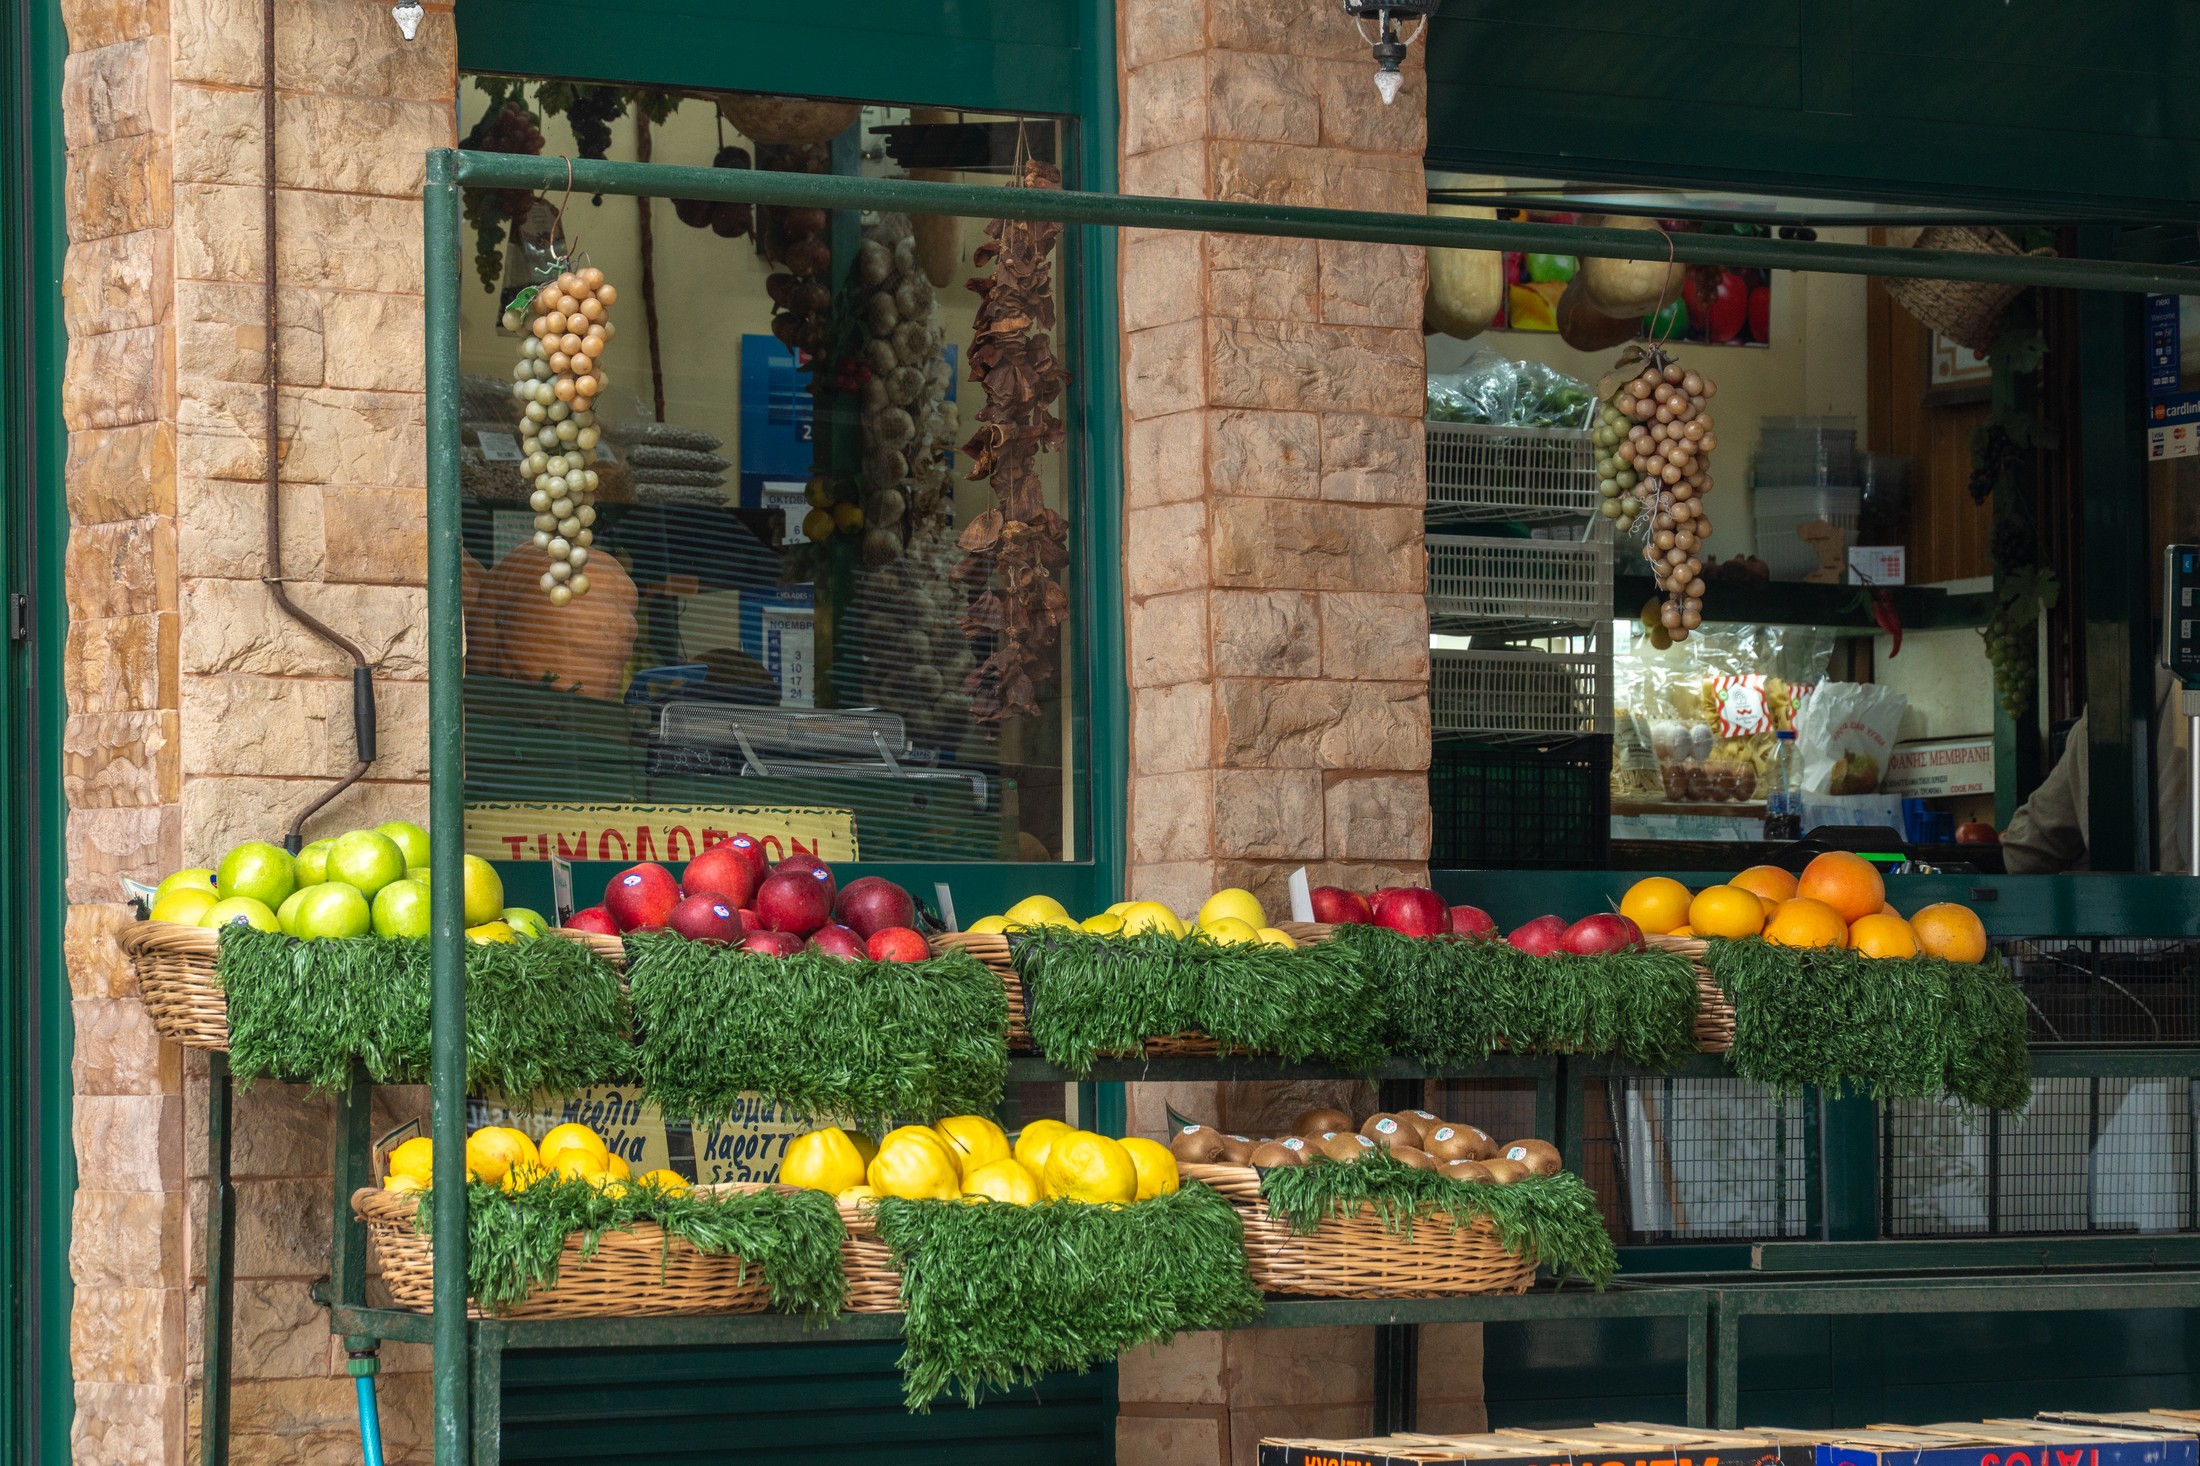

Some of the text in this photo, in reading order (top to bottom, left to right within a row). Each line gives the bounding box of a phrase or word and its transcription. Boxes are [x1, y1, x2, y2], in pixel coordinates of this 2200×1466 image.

[794, 525, 801, 535] 6
[776, 592, 808, 600] CYCLADES
[795, 651, 801, 661] 3
[790, 664, 802, 673] 10
[790, 676, 802, 686] 17
[790, 689, 802, 698] 24
[1930, 747, 1990, 767] ΜΕΜΒΡΑΝΗ
[1951, 783, 1983, 793] COOK PACK
